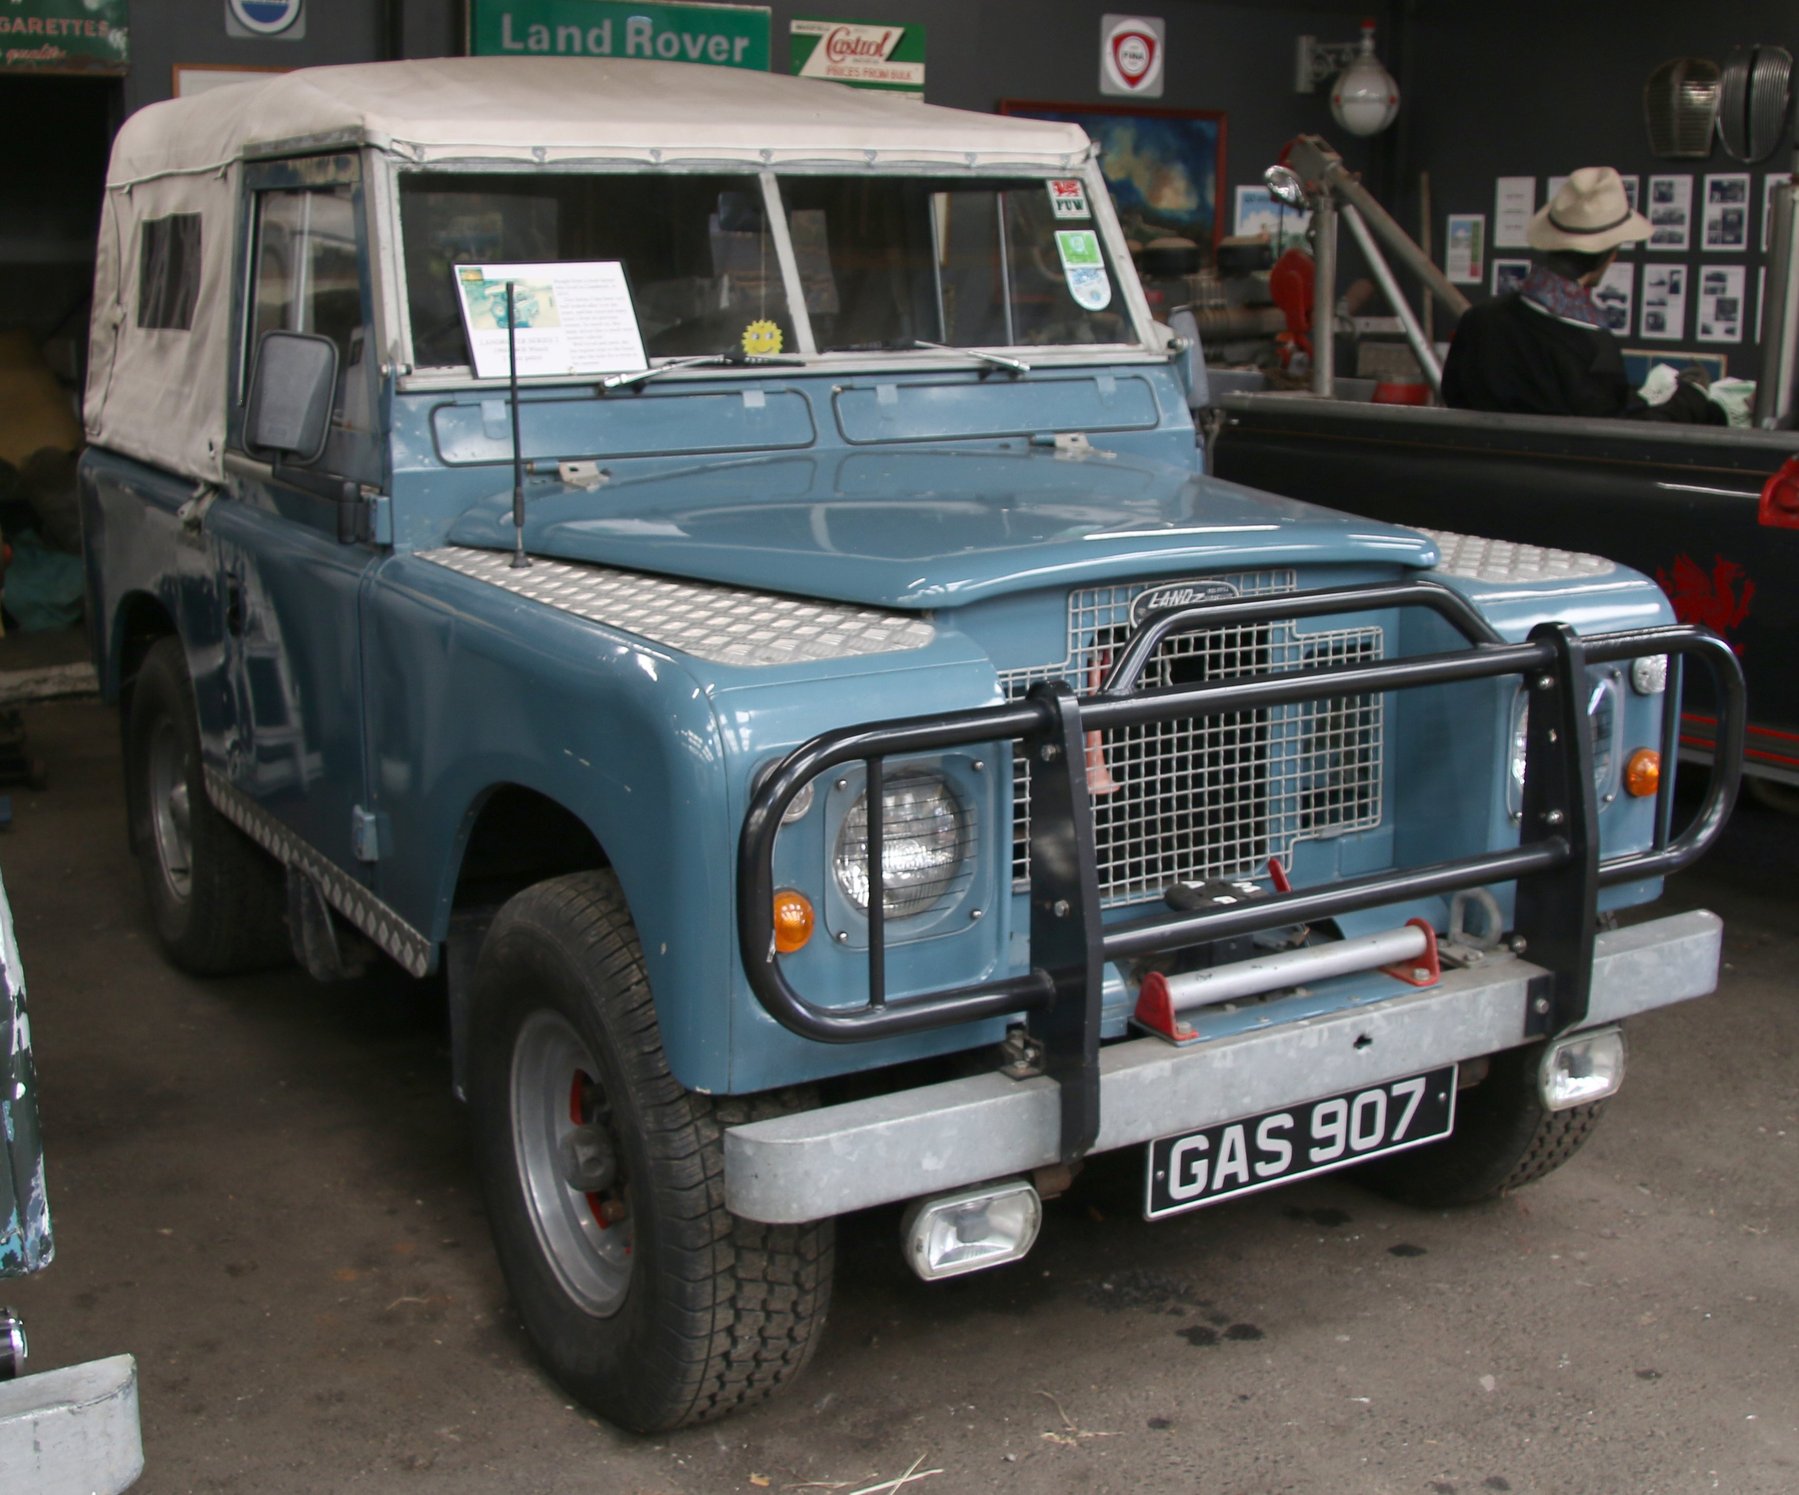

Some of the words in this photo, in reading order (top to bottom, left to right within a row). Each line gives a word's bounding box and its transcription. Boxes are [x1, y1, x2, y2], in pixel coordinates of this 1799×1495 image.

[502, 13, 612, 54] Land
[626, 16, 750, 63] Rover
[826, 26, 892, 63] Castrol
[1168, 1111, 1294, 1200] GAS
[1309, 1076, 1426, 1163] 907
